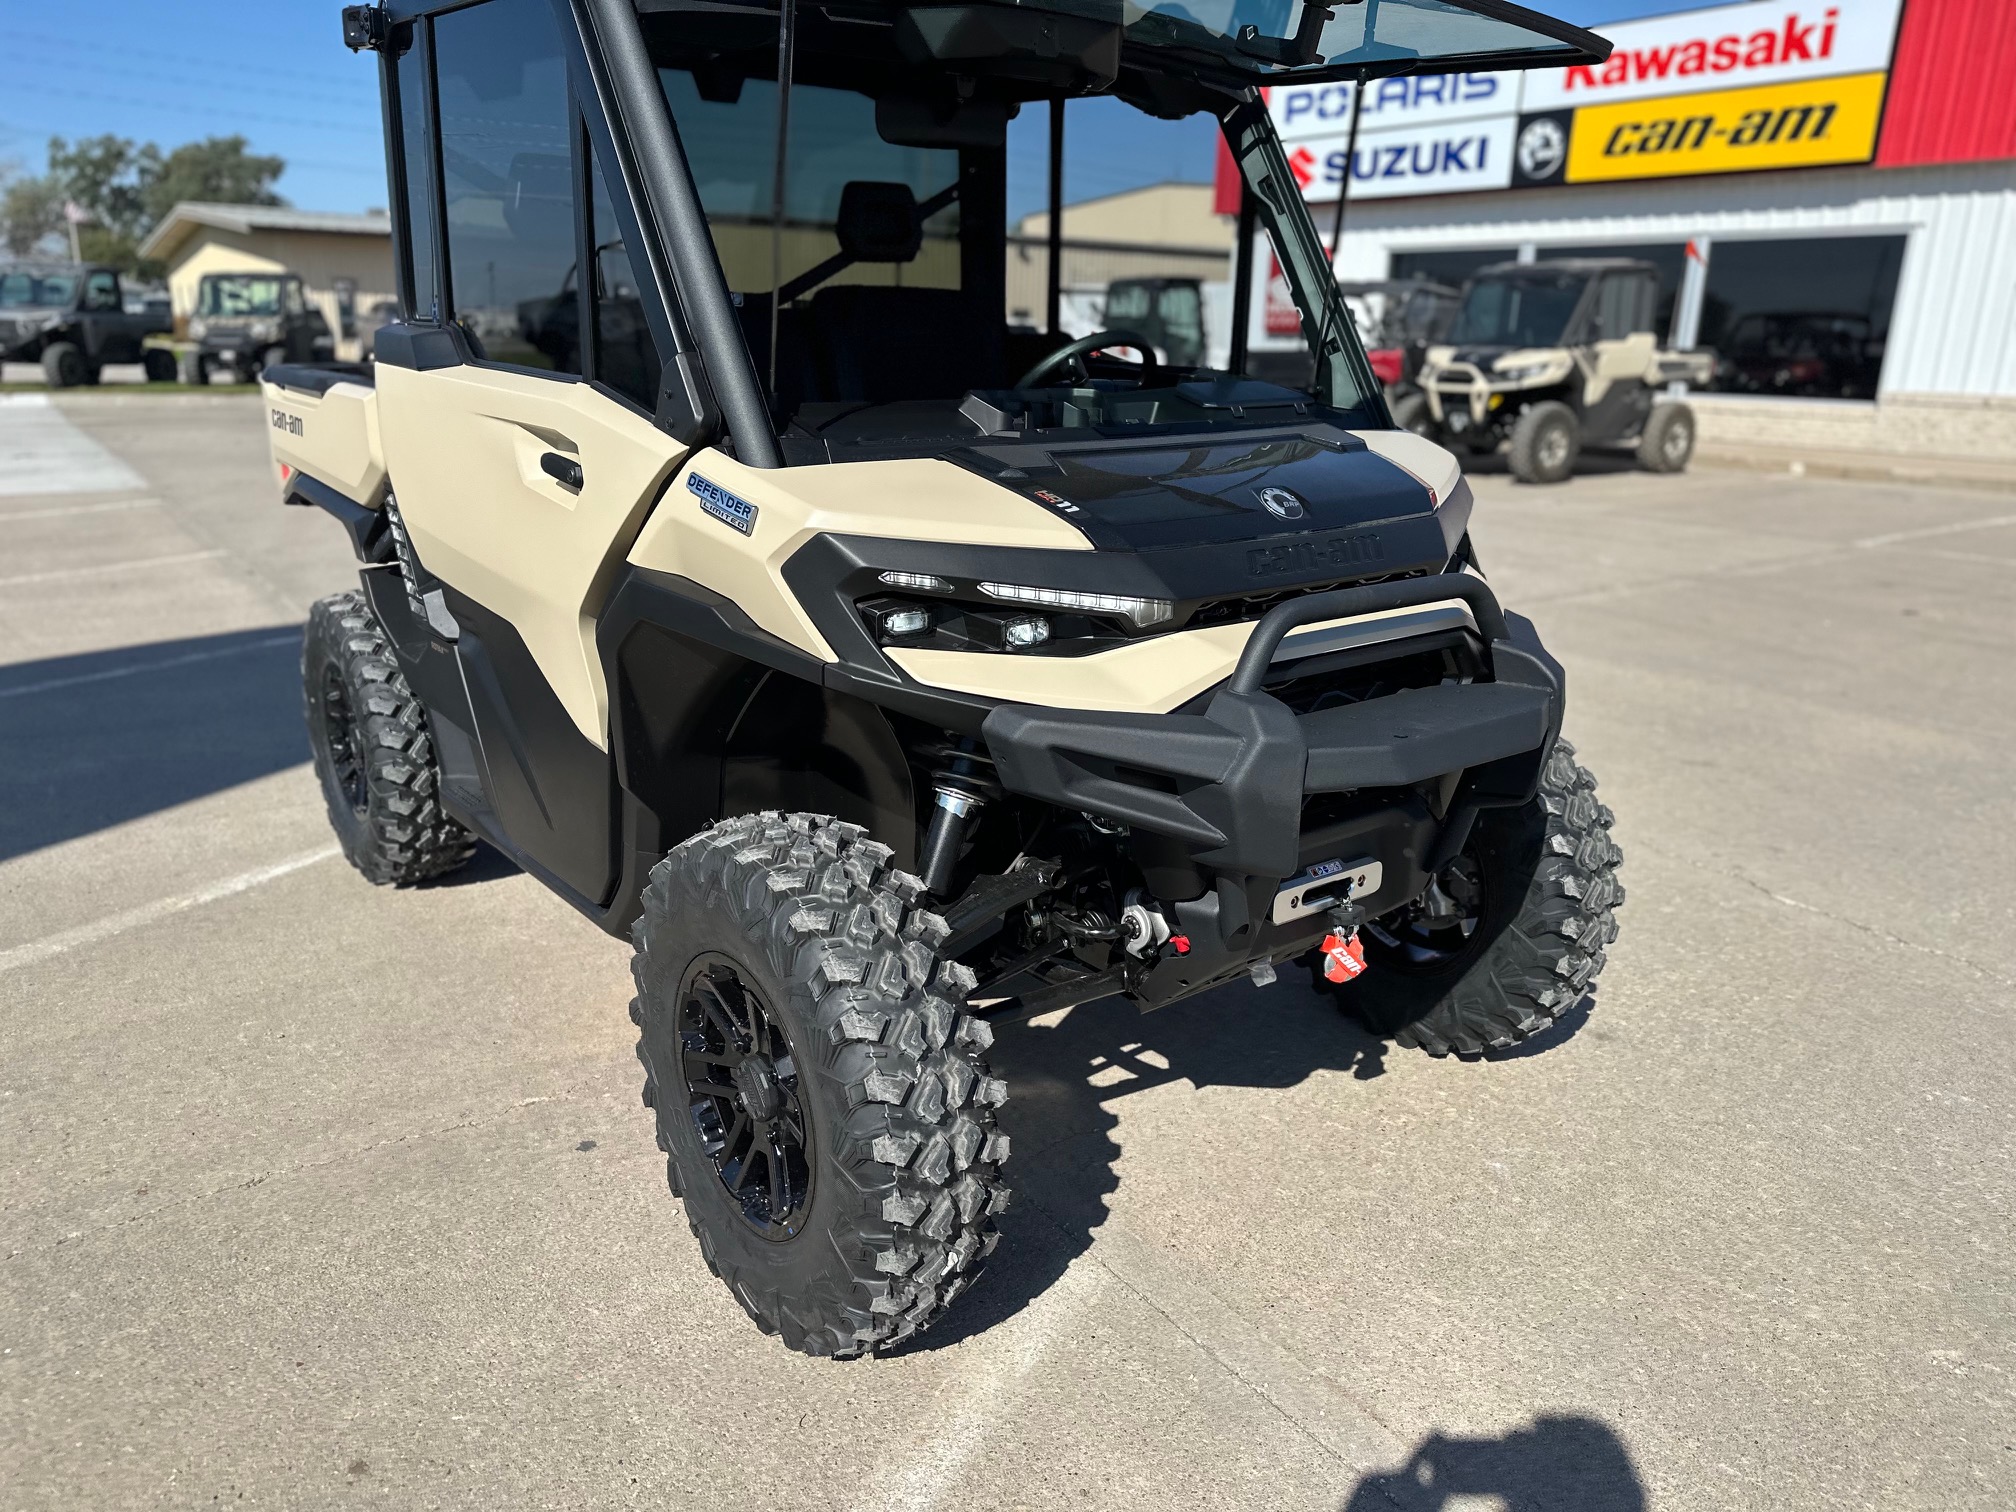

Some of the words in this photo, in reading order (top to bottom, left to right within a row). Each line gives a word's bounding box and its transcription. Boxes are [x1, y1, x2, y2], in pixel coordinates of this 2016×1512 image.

[1602, 102, 1838, 158] can-am
[1324, 137, 1488, 183] SUZUKI
[271, 408, 303, 437] can-am
[687, 475, 752, 519] DEFENDER
[1247, 534, 1384, 578] can-am
